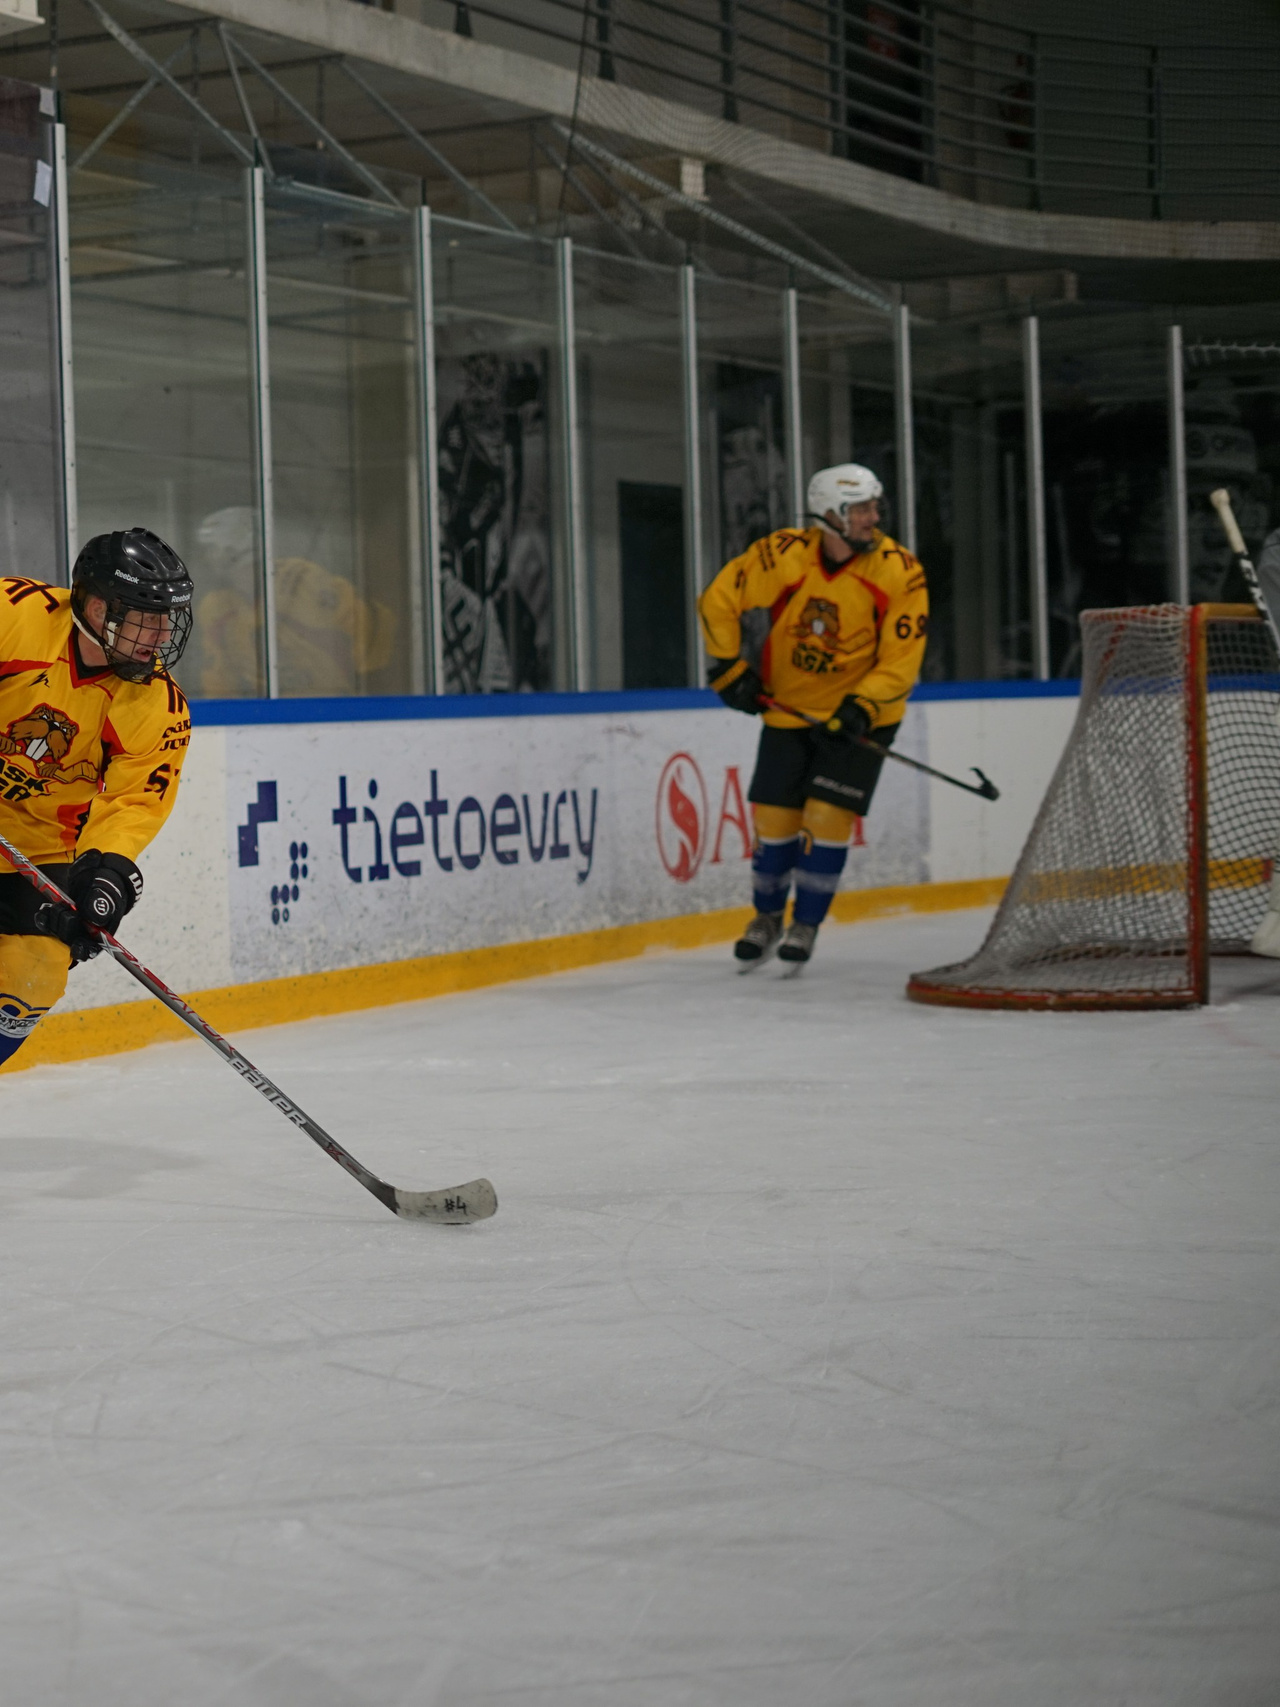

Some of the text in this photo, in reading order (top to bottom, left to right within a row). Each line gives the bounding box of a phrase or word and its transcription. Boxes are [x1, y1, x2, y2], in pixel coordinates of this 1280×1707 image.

[114, 568, 140, 585] Reebok
[171, 593, 192, 603] Reebok
[331, 769, 598, 886] tietoevry
[9, 851, 63, 903] VAP
[444, 1195, 468, 1216] #4
